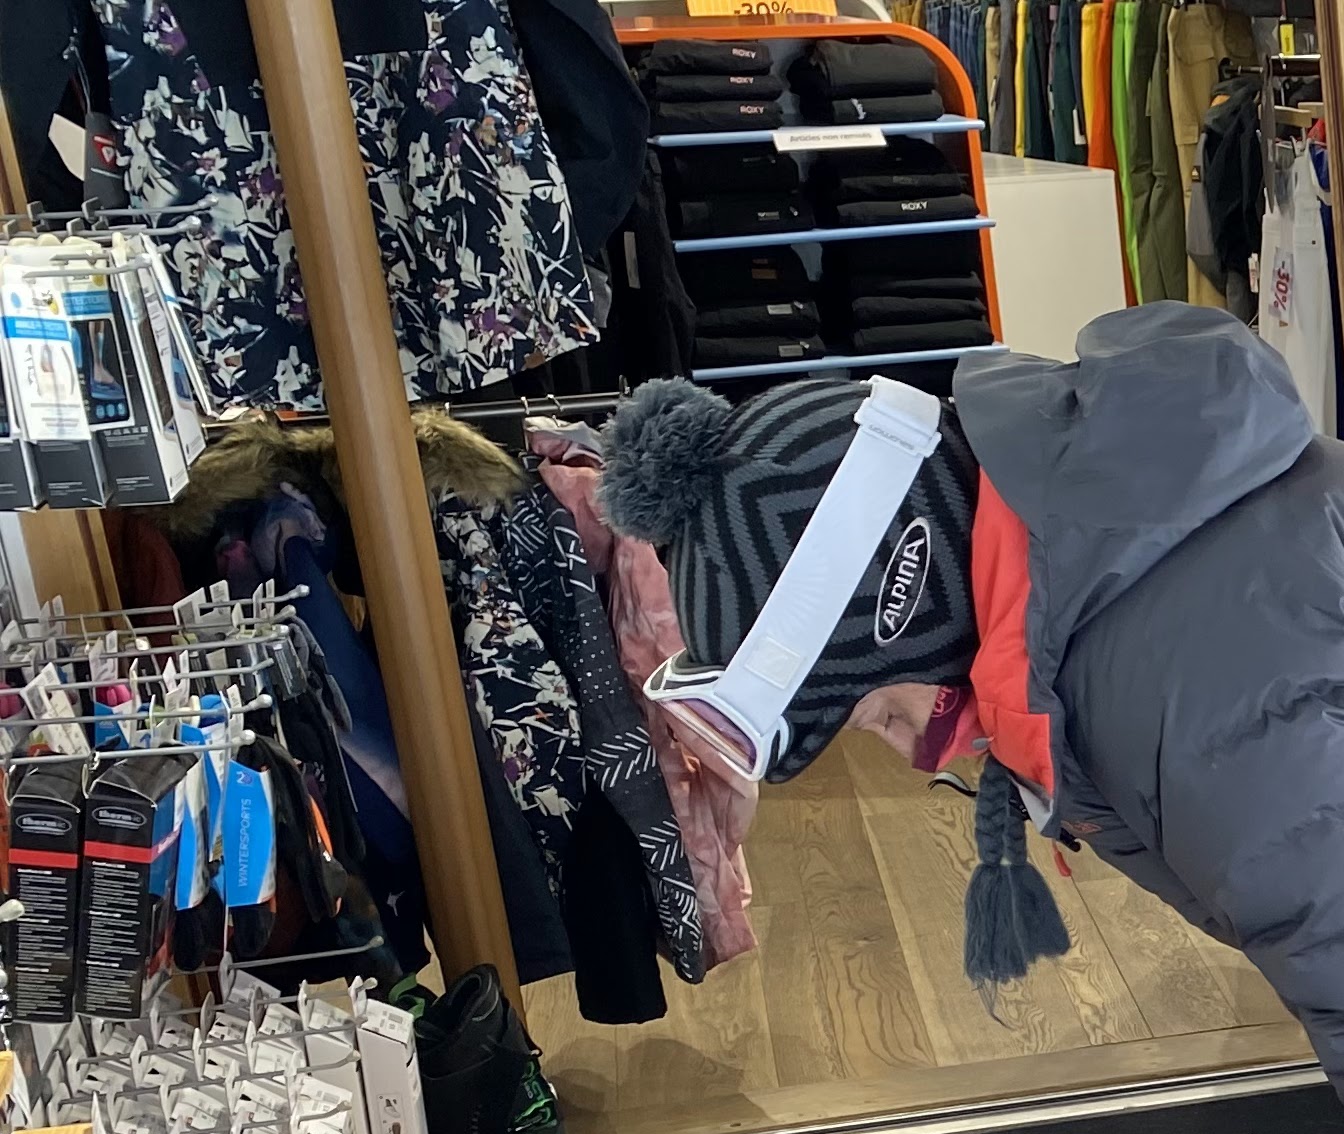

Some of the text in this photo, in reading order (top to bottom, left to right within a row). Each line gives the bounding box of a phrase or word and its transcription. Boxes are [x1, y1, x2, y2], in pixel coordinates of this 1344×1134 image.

[901, 201, 928, 210] ROXY
[881, 536, 926, 632] ALPINA
[237, 798, 252, 888] WINTERSPORTS
